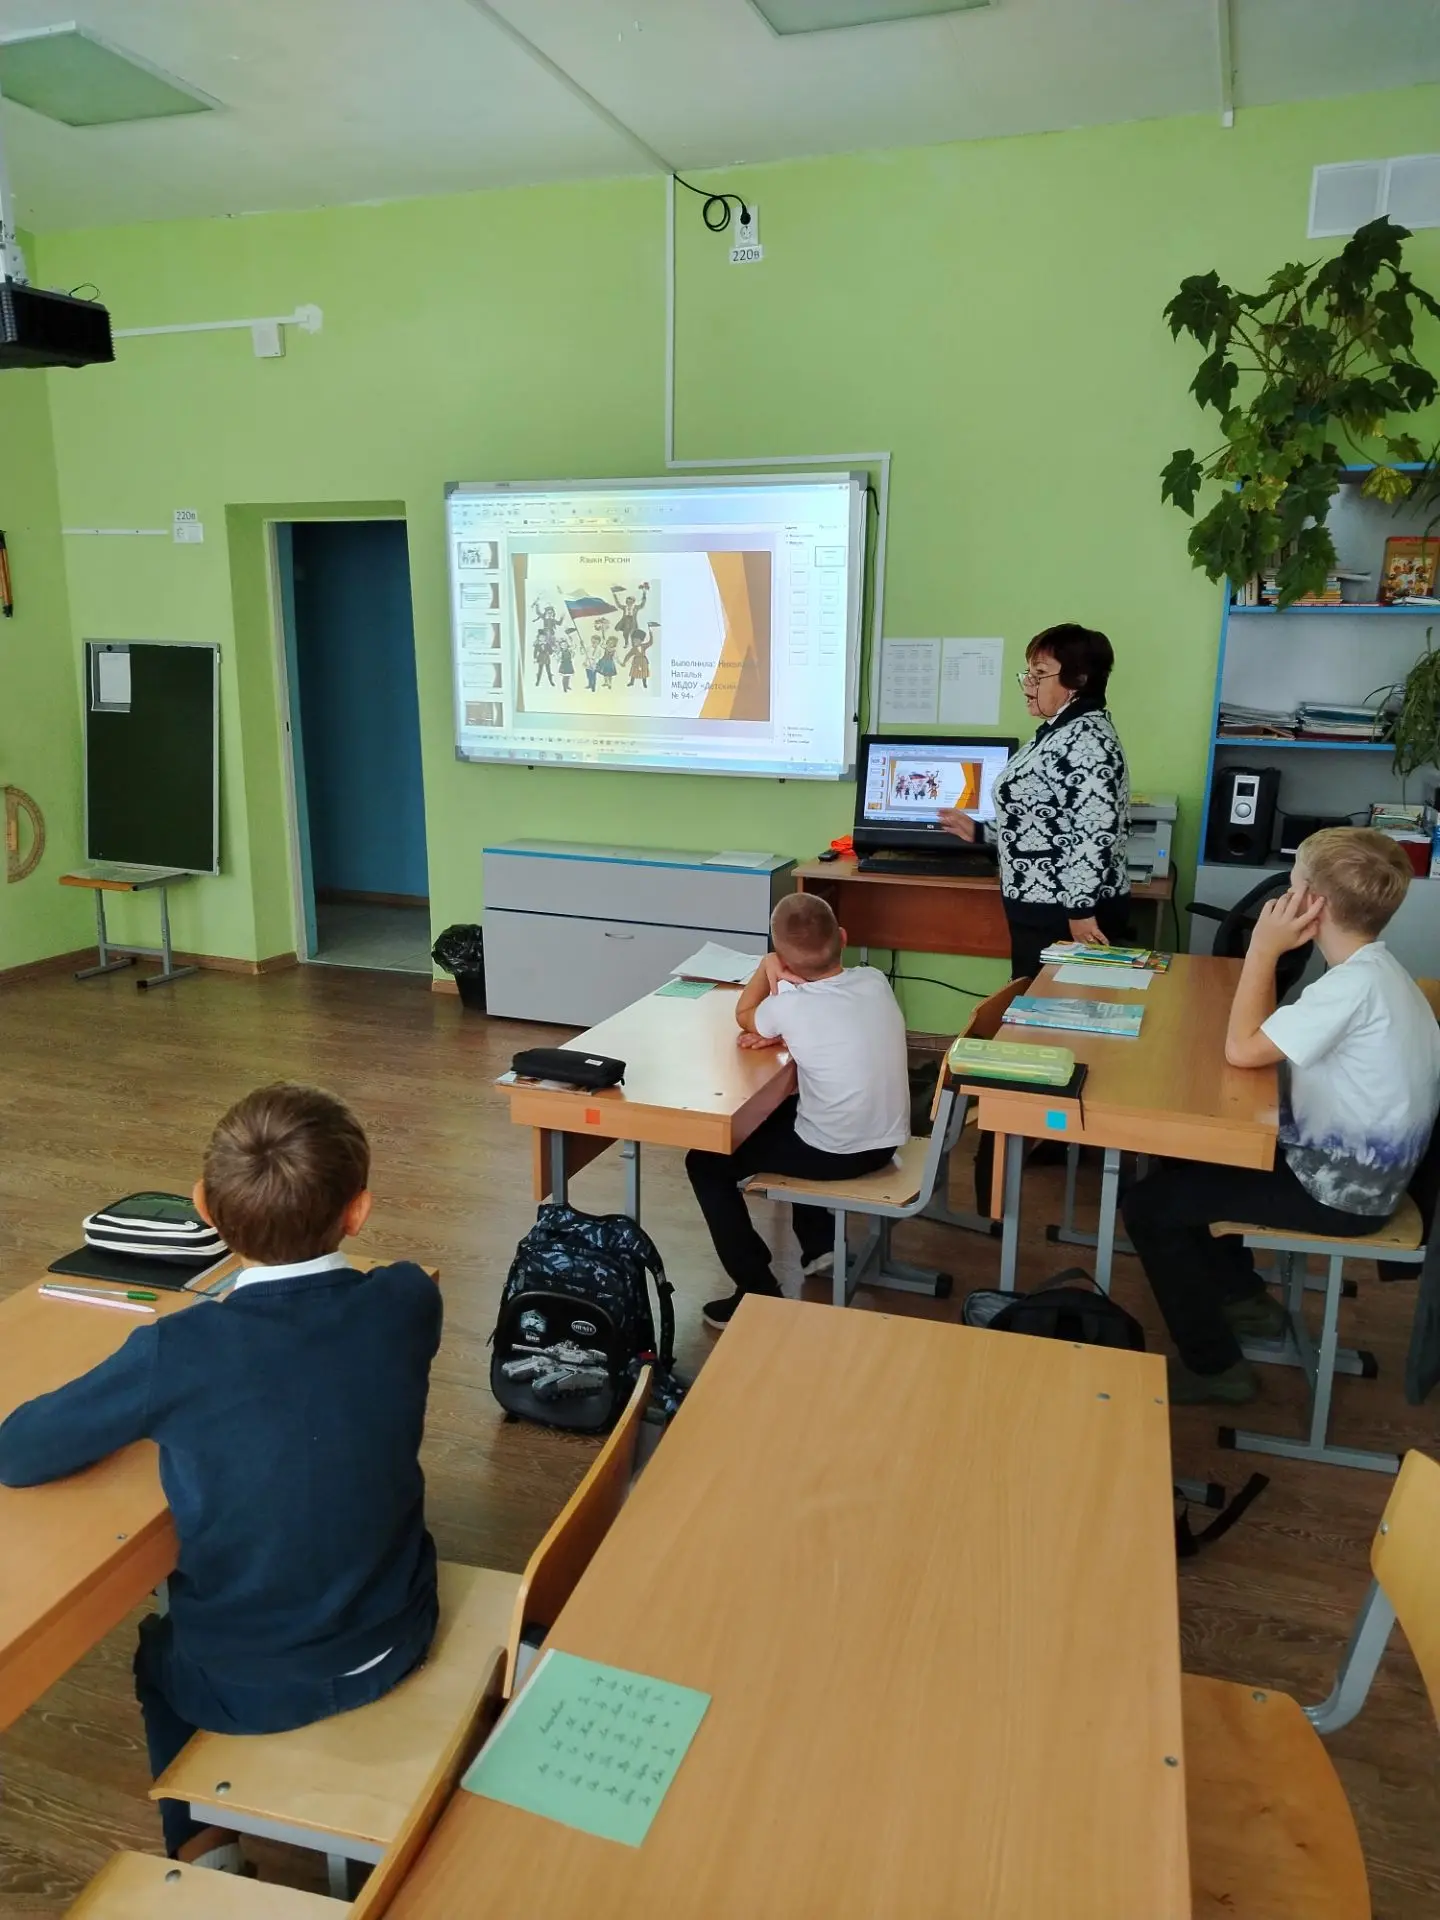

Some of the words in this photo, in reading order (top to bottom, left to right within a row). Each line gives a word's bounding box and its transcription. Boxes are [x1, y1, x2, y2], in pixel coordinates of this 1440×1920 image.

[579, 555, 603, 564] Языки
[604, 555, 631, 564] России
[670, 670, 702, 679] Наталья
[670, 681, 698, 691] МБДОУ
[671, 692, 680, 700] №
